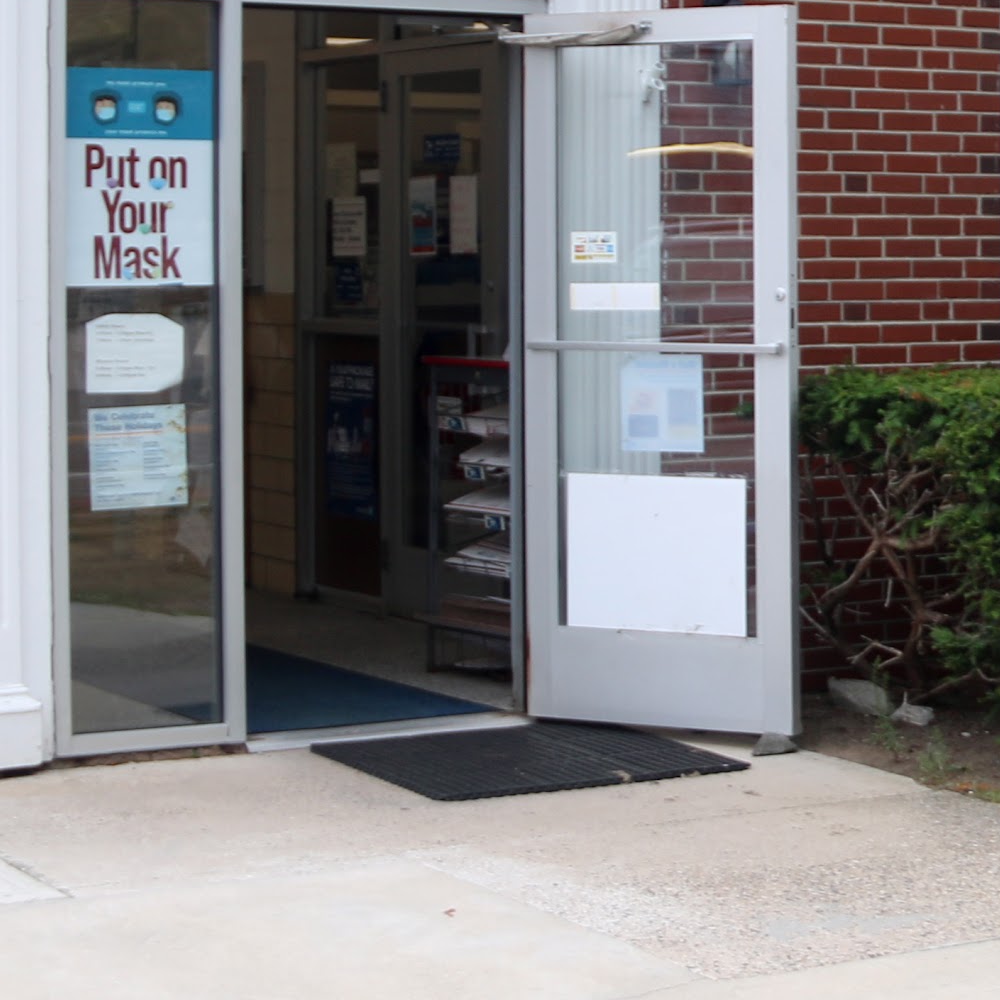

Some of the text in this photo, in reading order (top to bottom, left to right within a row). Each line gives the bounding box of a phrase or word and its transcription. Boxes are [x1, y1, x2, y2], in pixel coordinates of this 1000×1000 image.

[85, 143, 187, 189] Put on
[101, 189, 174, 234] Your
[94, 235, 182, 279] Mask
